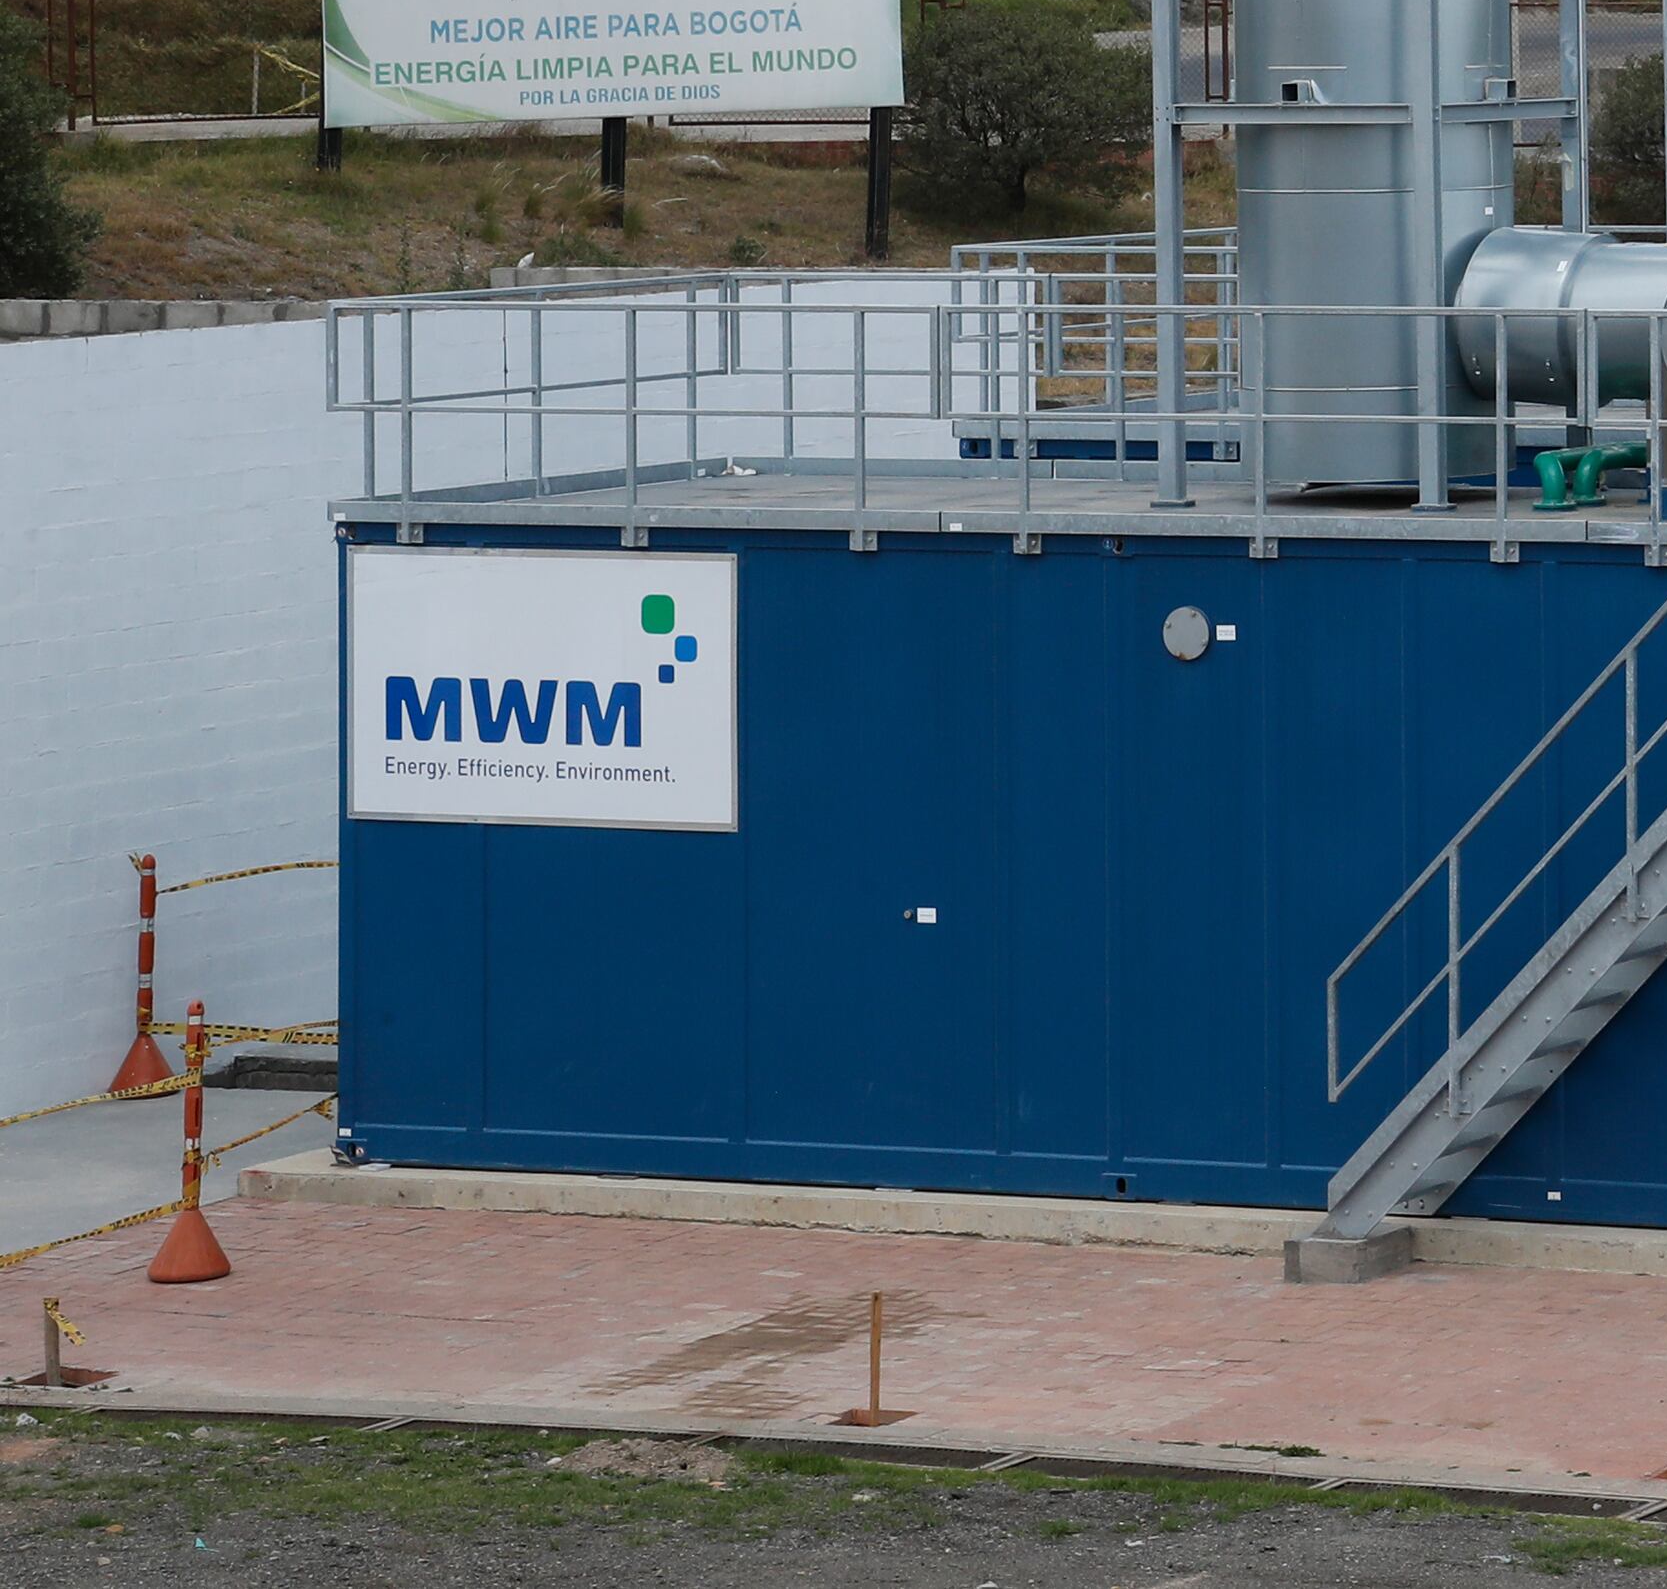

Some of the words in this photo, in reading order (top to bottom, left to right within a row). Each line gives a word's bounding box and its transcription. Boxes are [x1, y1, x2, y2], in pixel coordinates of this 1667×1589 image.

[430, 18, 525, 44] MEJOR
[535, 15, 599, 40] AIRE
[608, 12, 681, 38] PARA
[689, 2, 803, 36] BOGOTÁ
[374, 53, 507, 85] ENERGÍA
[516, 56, 614, 81] LIMPIA
[623, 53, 700, 77] PARA
[709, 52, 744, 75] EL
[752, 47, 858, 73] MUNDO
[519, 90, 555, 106] POR
[560, 89, 581, 105] LA
[586, 86, 650, 103] GRACIA
[655, 85, 677, 102] DE
[681, 84, 721, 101] DIOS
[385, 675, 642, 748] MWM
[385, 756, 452, 780] Energy.
[457, 758, 550, 784] Efficiency.
[555, 761, 676, 784] Environment.
